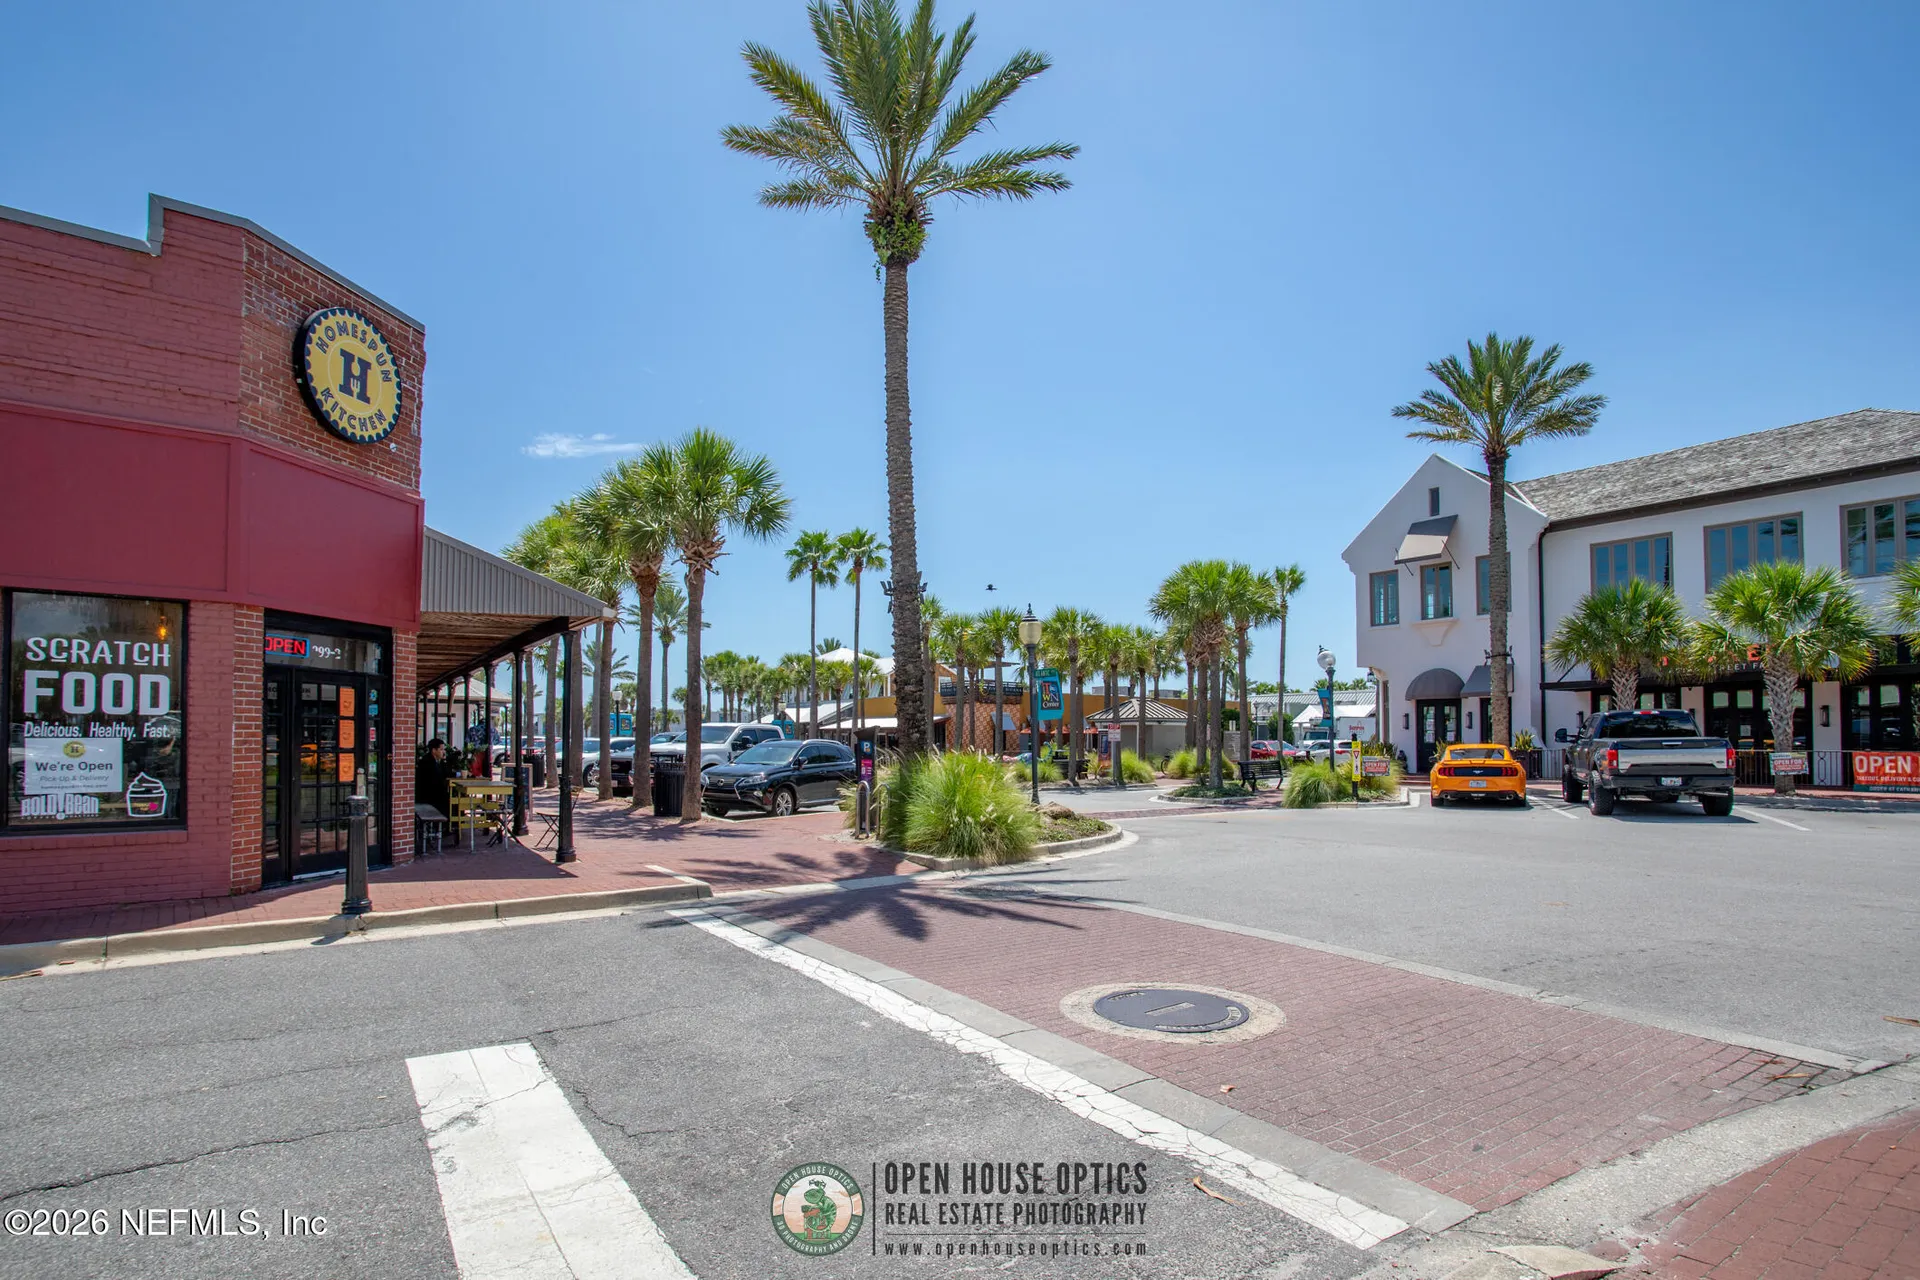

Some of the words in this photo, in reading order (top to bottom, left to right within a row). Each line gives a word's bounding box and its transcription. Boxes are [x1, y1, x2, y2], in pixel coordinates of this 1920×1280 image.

[315, 321, 392, 383] HOMESPUN
[338, 347, 372, 405] H
[321, 387, 387, 432] KITCHEN
[25, 637, 171, 667] SCRATCH
[23, 669, 171, 716] FOOD
[1042, 701, 1060, 709] Center
[24, 721, 82, 738] Delicious.
[89, 722, 136, 741] Healthy.
[143, 722, 171, 738] Fast.
[35, 762, 74, 771] We're
[78, 761, 113, 772] Open
[1855, 755, 1912, 774] OPEN
